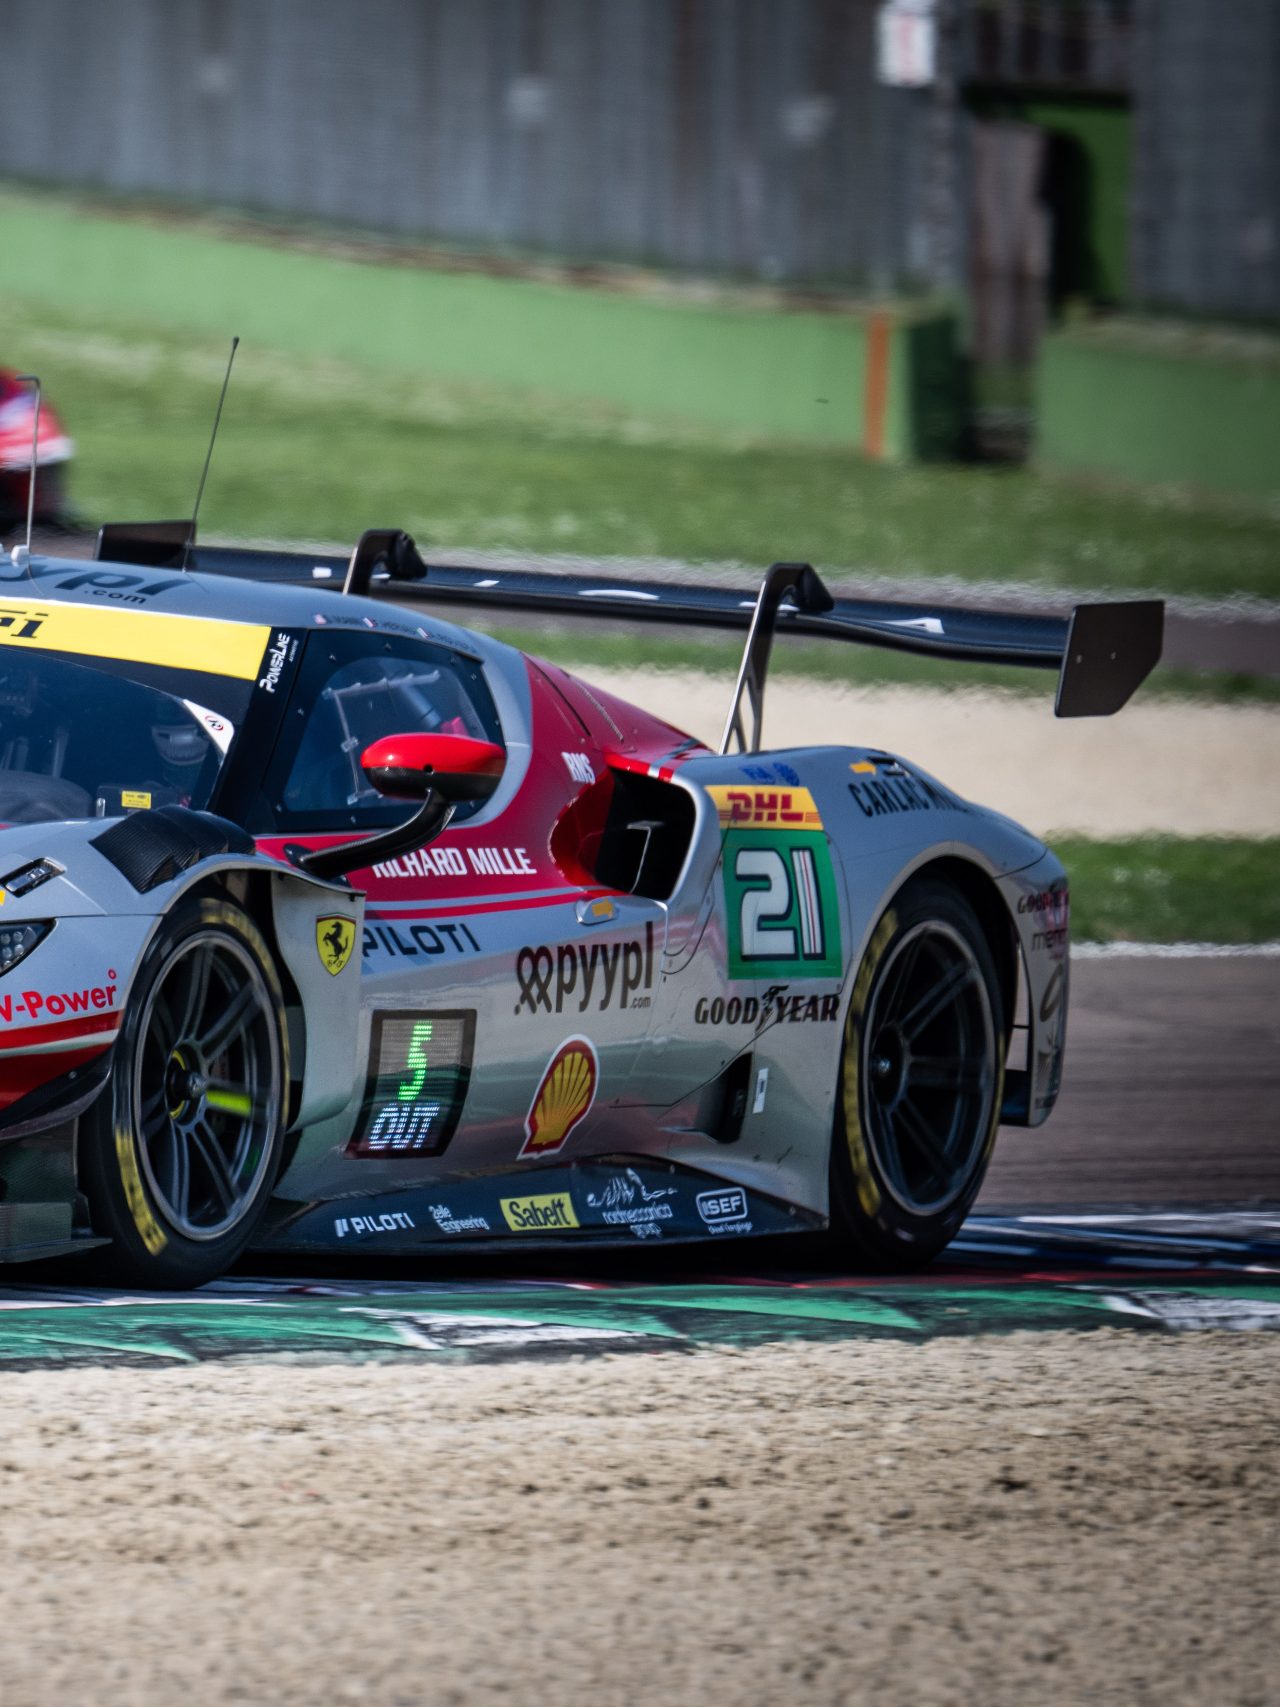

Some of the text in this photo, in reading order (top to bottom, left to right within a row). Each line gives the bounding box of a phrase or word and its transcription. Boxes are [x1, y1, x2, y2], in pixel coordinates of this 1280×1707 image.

[84, 588, 147, 605] .com
[727, 792, 804, 822] DHL
[370, 847, 538, 879] RICHARD MILLE
[734, 846, 827, 962] 21
[363, 922, 481, 958] PILOTI
[555, 920, 654, 1014] pyypl
[368, 1102, 441, 1150] OUT
[353, 1212, 416, 1233] PILOTI
[508, 1197, 571, 1229] Sabelt
